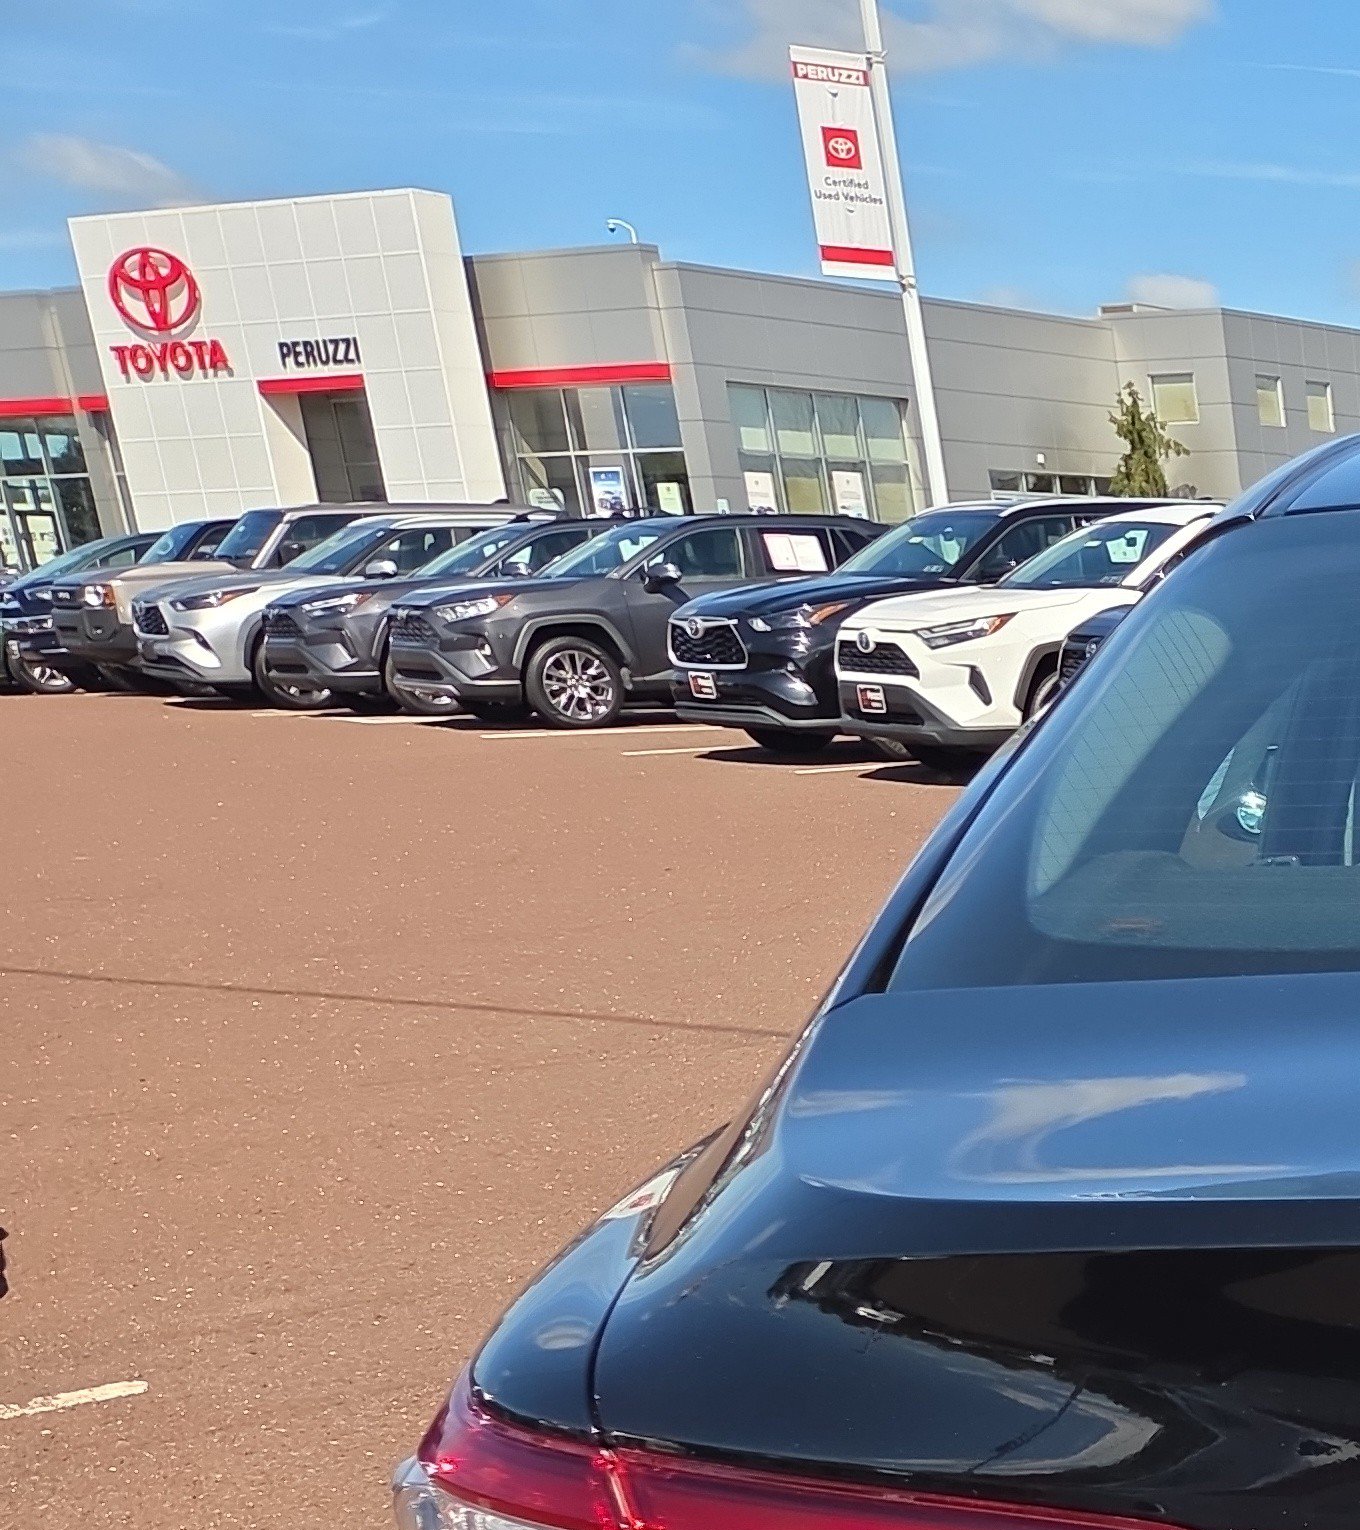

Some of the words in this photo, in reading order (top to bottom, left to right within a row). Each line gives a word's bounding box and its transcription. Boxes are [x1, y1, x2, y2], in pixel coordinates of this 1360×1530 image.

[796, 64, 865, 85] PERUZZI
[824, 177, 869, 190] Certified
[813, 189, 841, 202] Used
[842, 192, 883, 205] Vehicles
[109, 339, 232, 381] TOYOTA
[277, 336, 361, 370] PERUZZI
